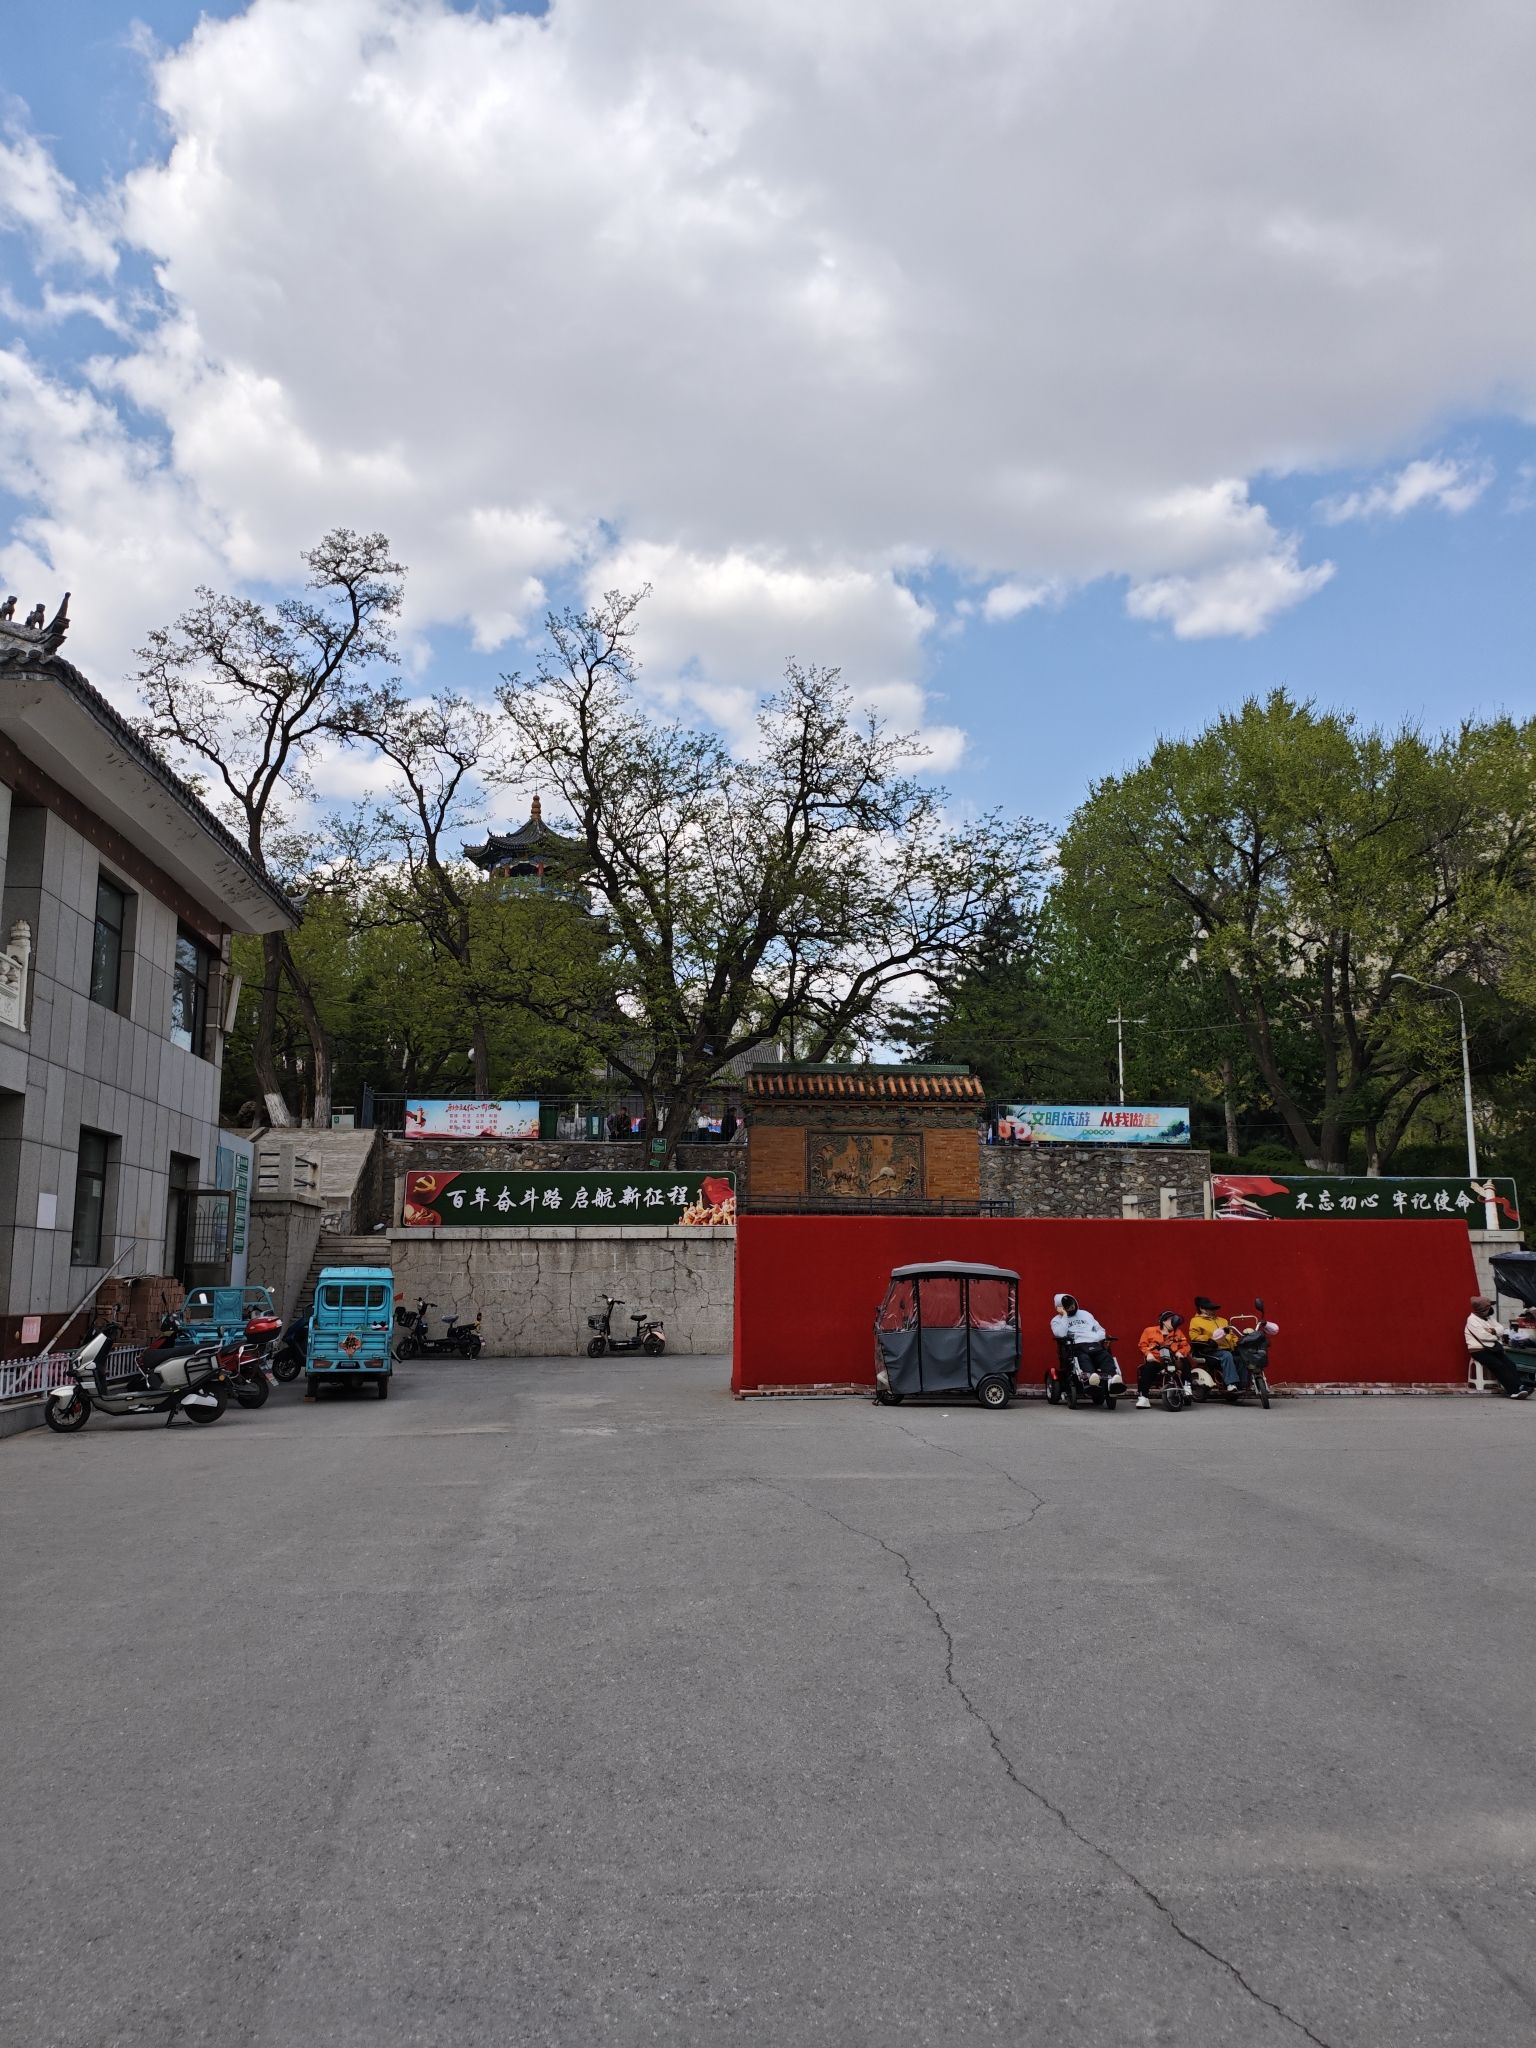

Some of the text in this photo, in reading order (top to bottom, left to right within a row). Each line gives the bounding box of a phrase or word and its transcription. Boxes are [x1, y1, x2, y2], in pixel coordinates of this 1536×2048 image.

[1031, 1111, 1160, 1128] 文明旅游 从我做起
[446, 1186, 689, 1213] 百年奋斗路 启航新征程
[1295, 1190, 1475, 1214] 不忘初心 牢记使命
